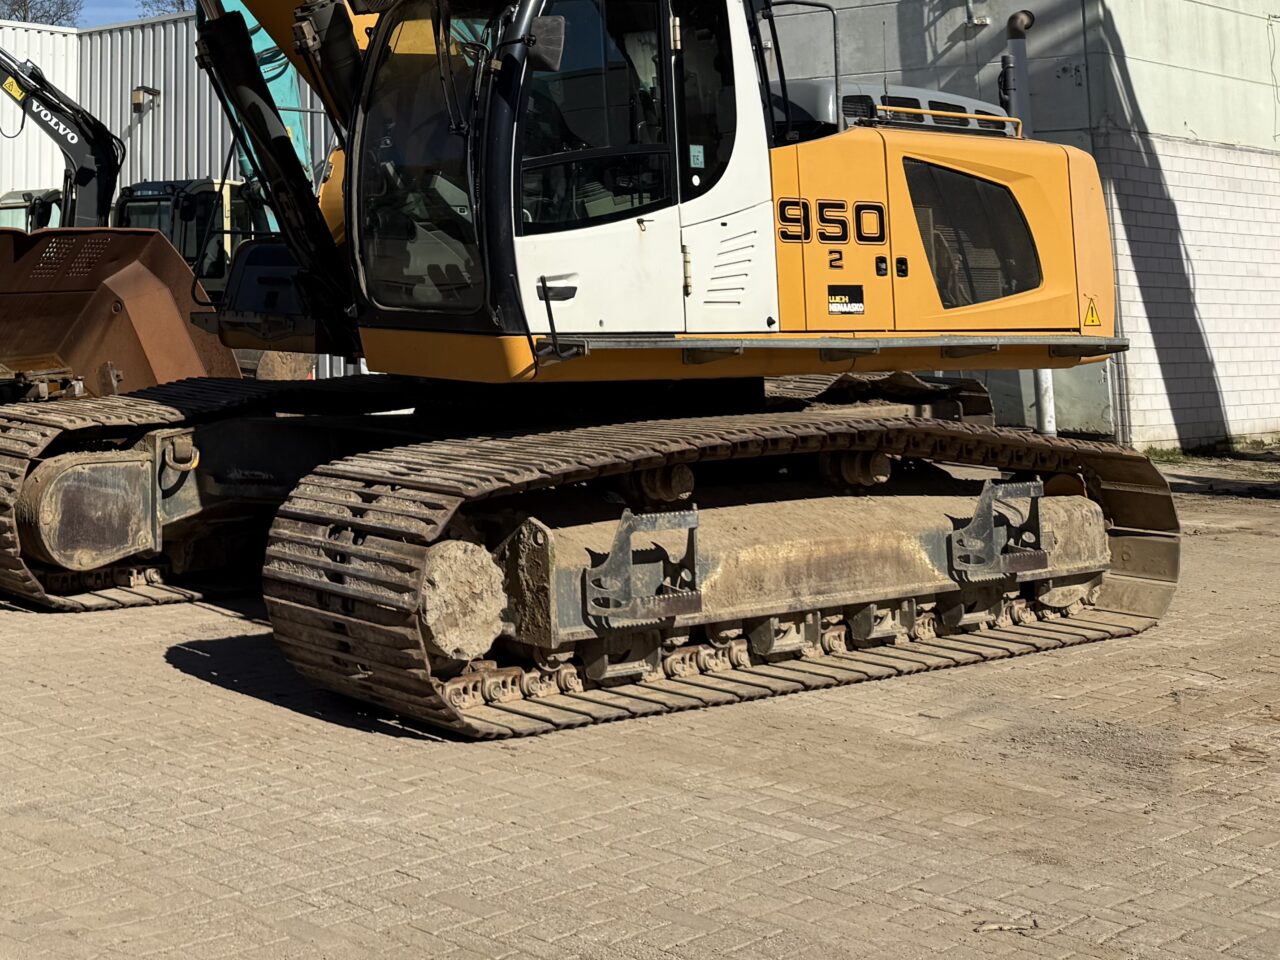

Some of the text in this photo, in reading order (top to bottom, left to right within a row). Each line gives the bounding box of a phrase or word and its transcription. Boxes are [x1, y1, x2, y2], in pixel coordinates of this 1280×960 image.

[30, 99, 79, 145] VOLVO
[778, 197, 887, 245] 950
[828, 249, 844, 270] 2
